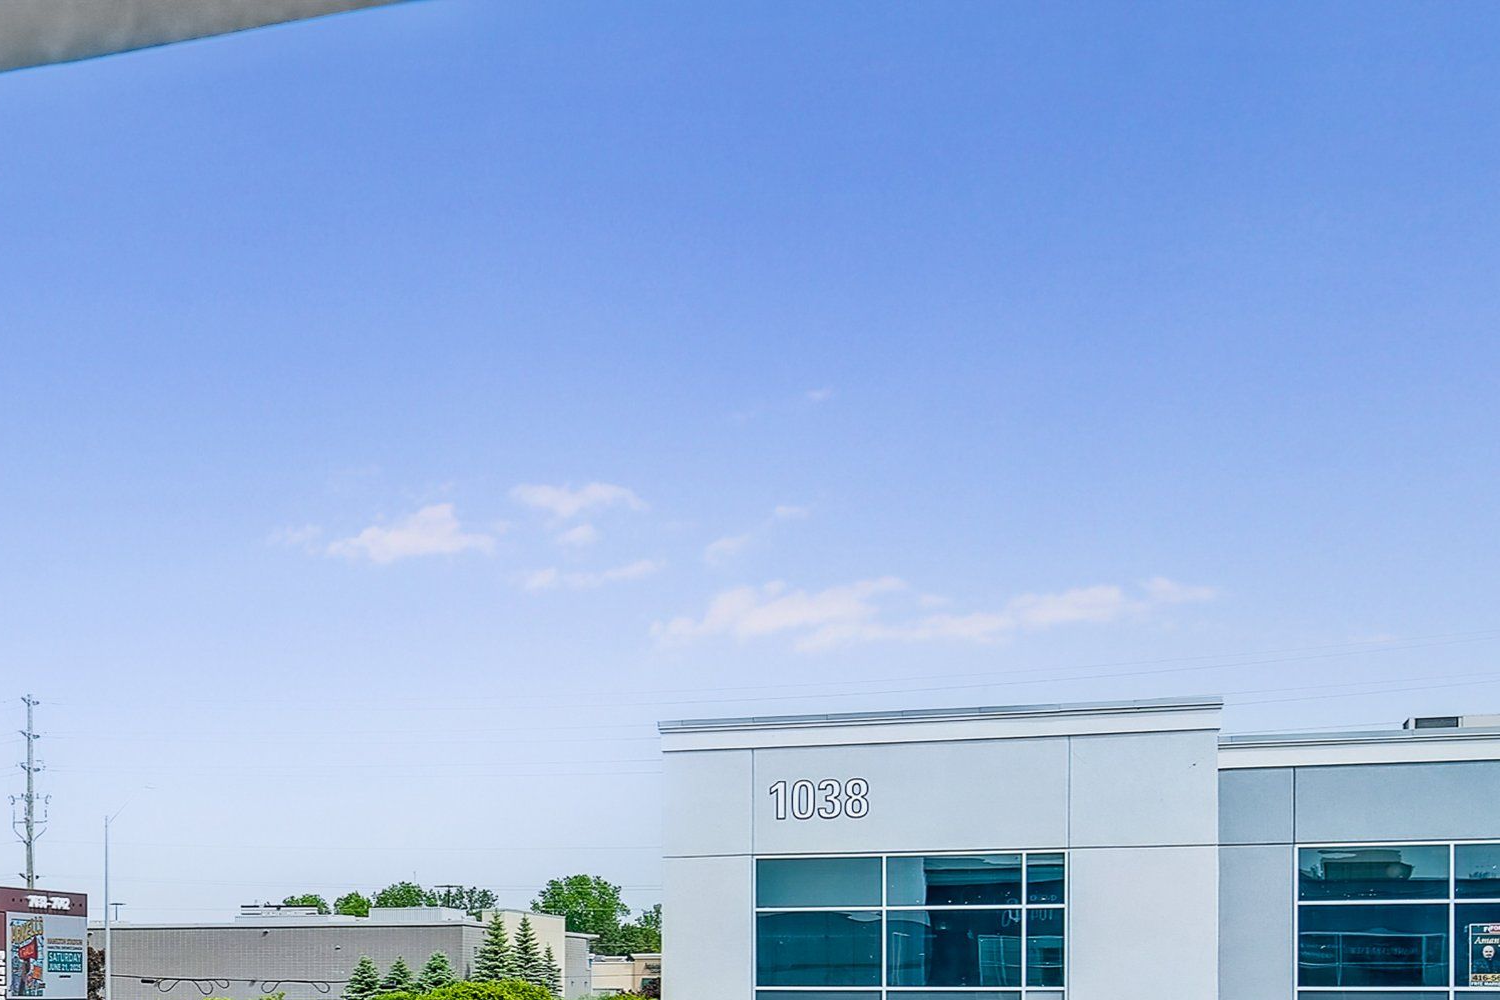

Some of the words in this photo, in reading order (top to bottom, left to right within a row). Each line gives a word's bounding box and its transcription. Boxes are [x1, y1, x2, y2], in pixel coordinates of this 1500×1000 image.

[768, 777, 870, 821] 1038
[48, 952, 82, 962] SATURDAY
[48, 963, 61, 971] JUNE
